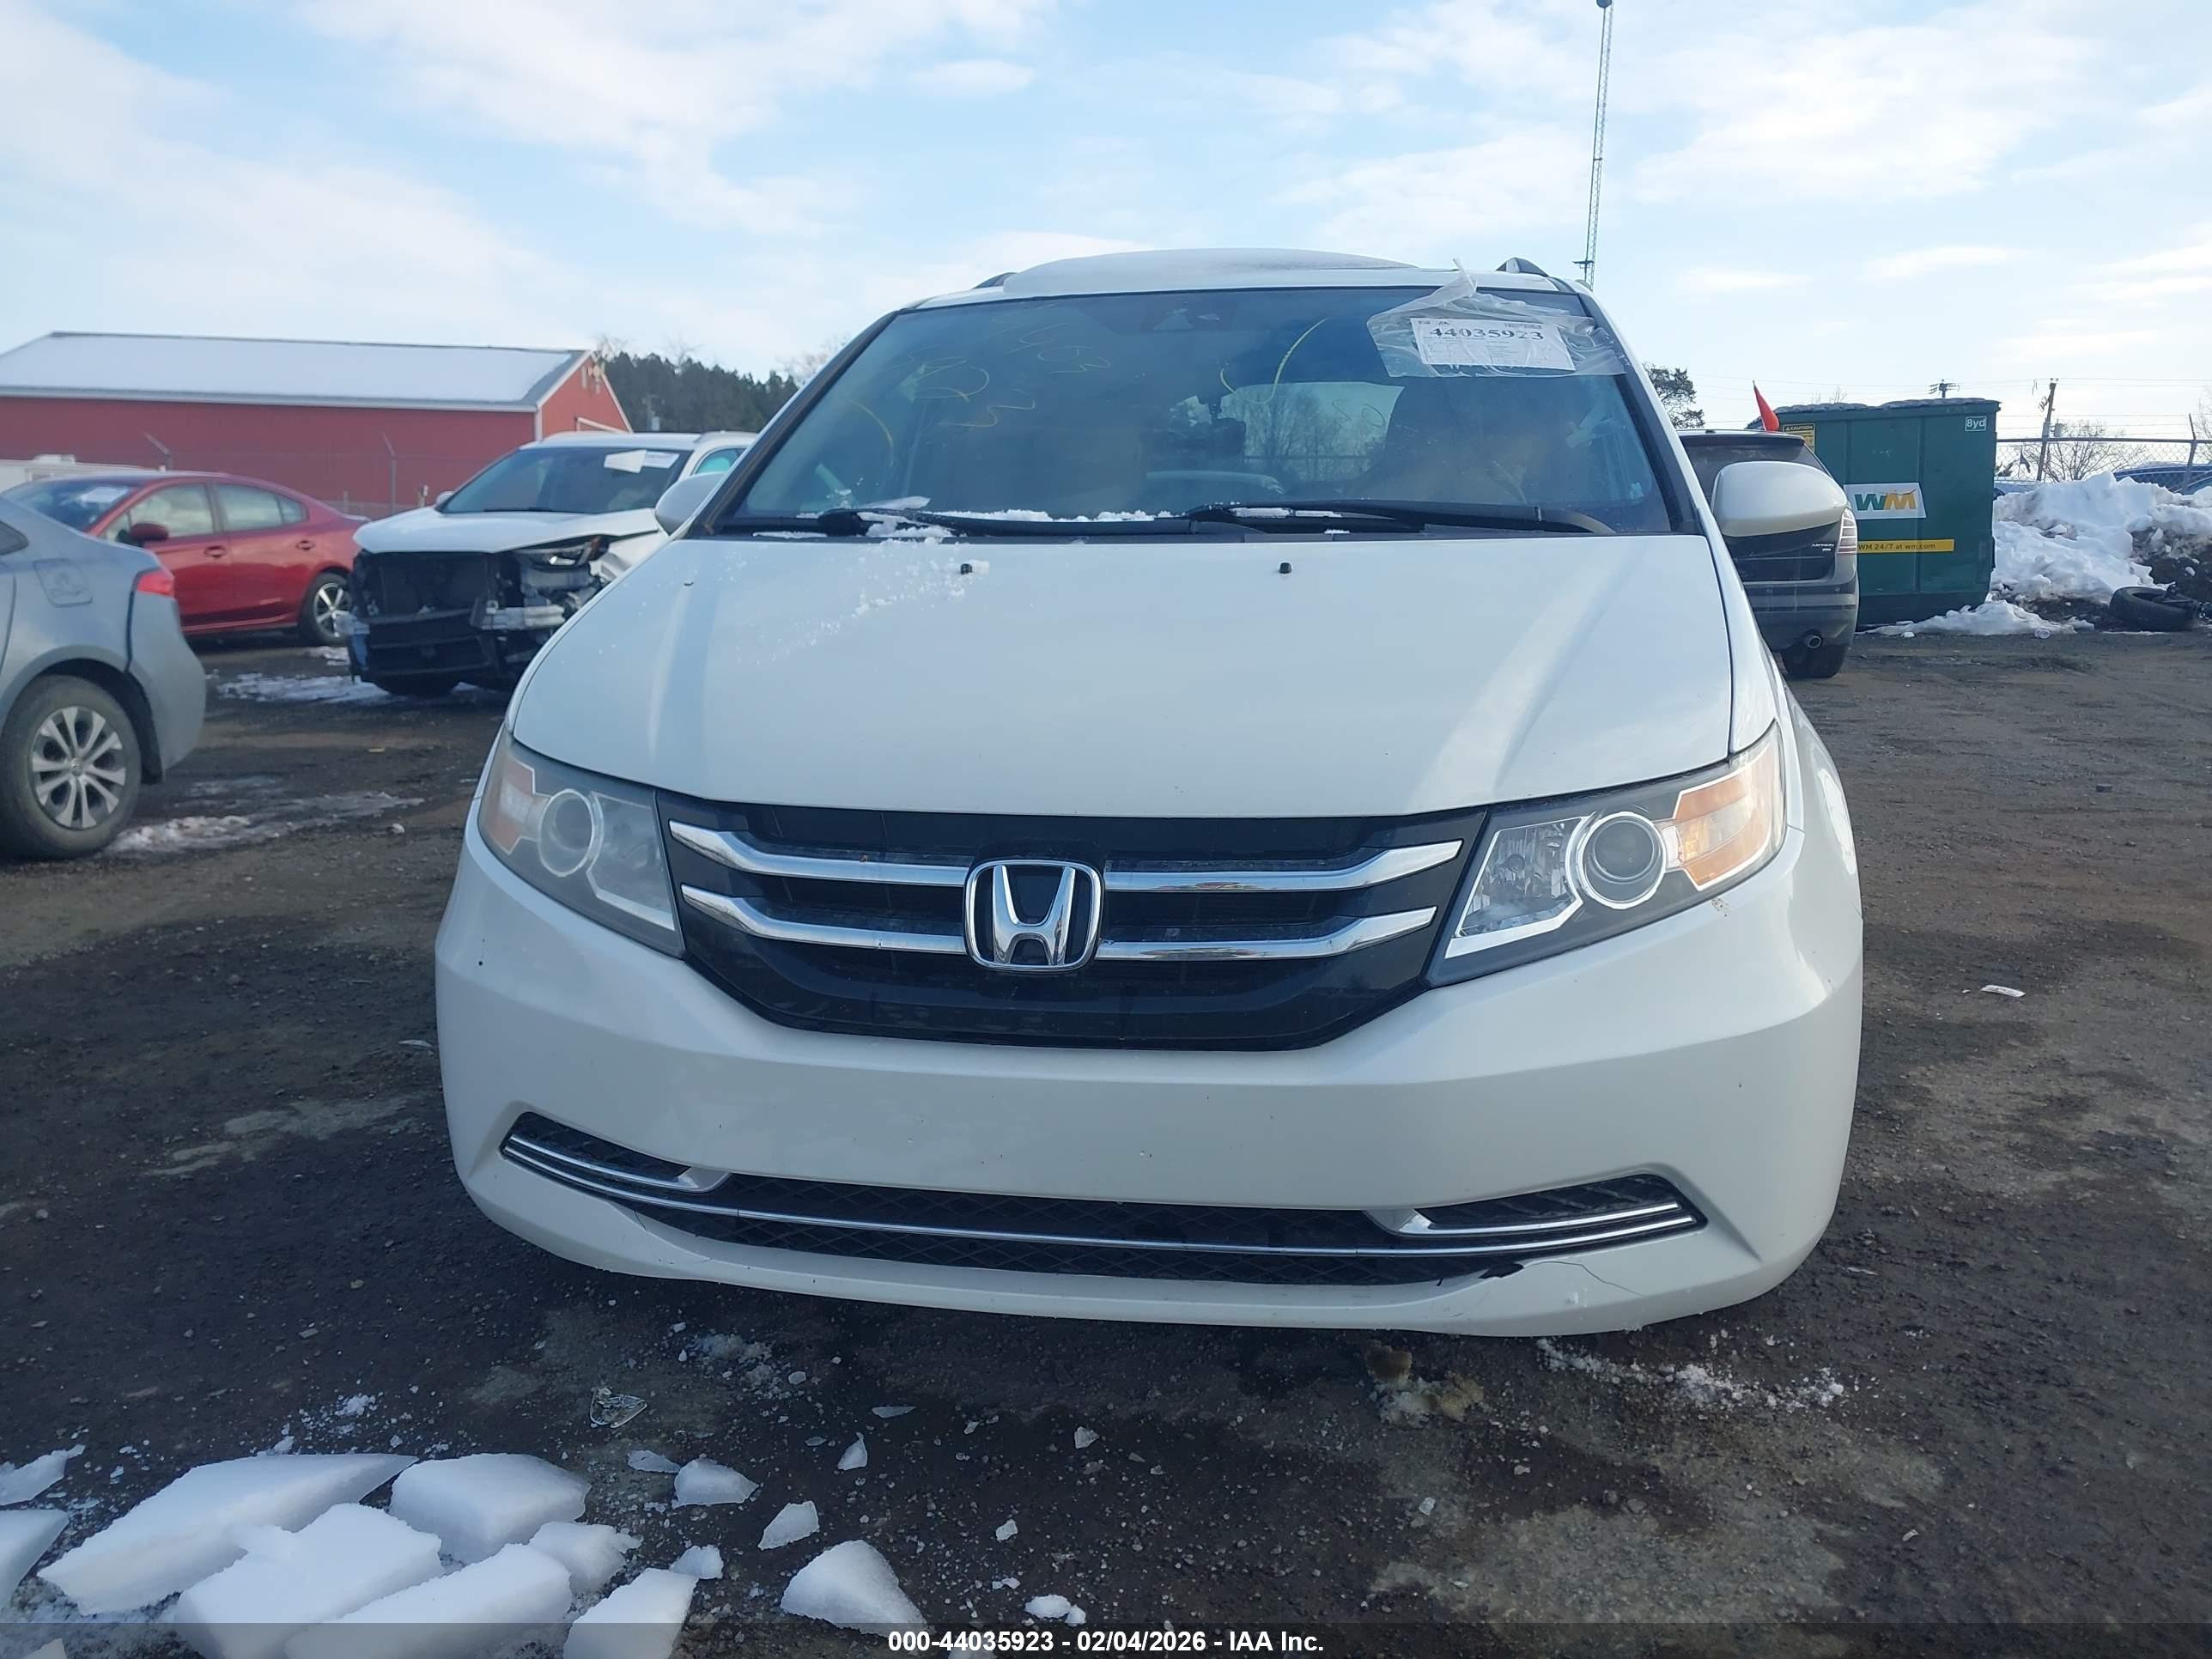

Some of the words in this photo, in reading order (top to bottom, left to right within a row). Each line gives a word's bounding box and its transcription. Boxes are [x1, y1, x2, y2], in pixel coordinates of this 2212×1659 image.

[1430, 328, 1544, 340] 44035923
[1967, 418, 1985, 429] 8yd
[1855, 493, 1916, 511] WM
